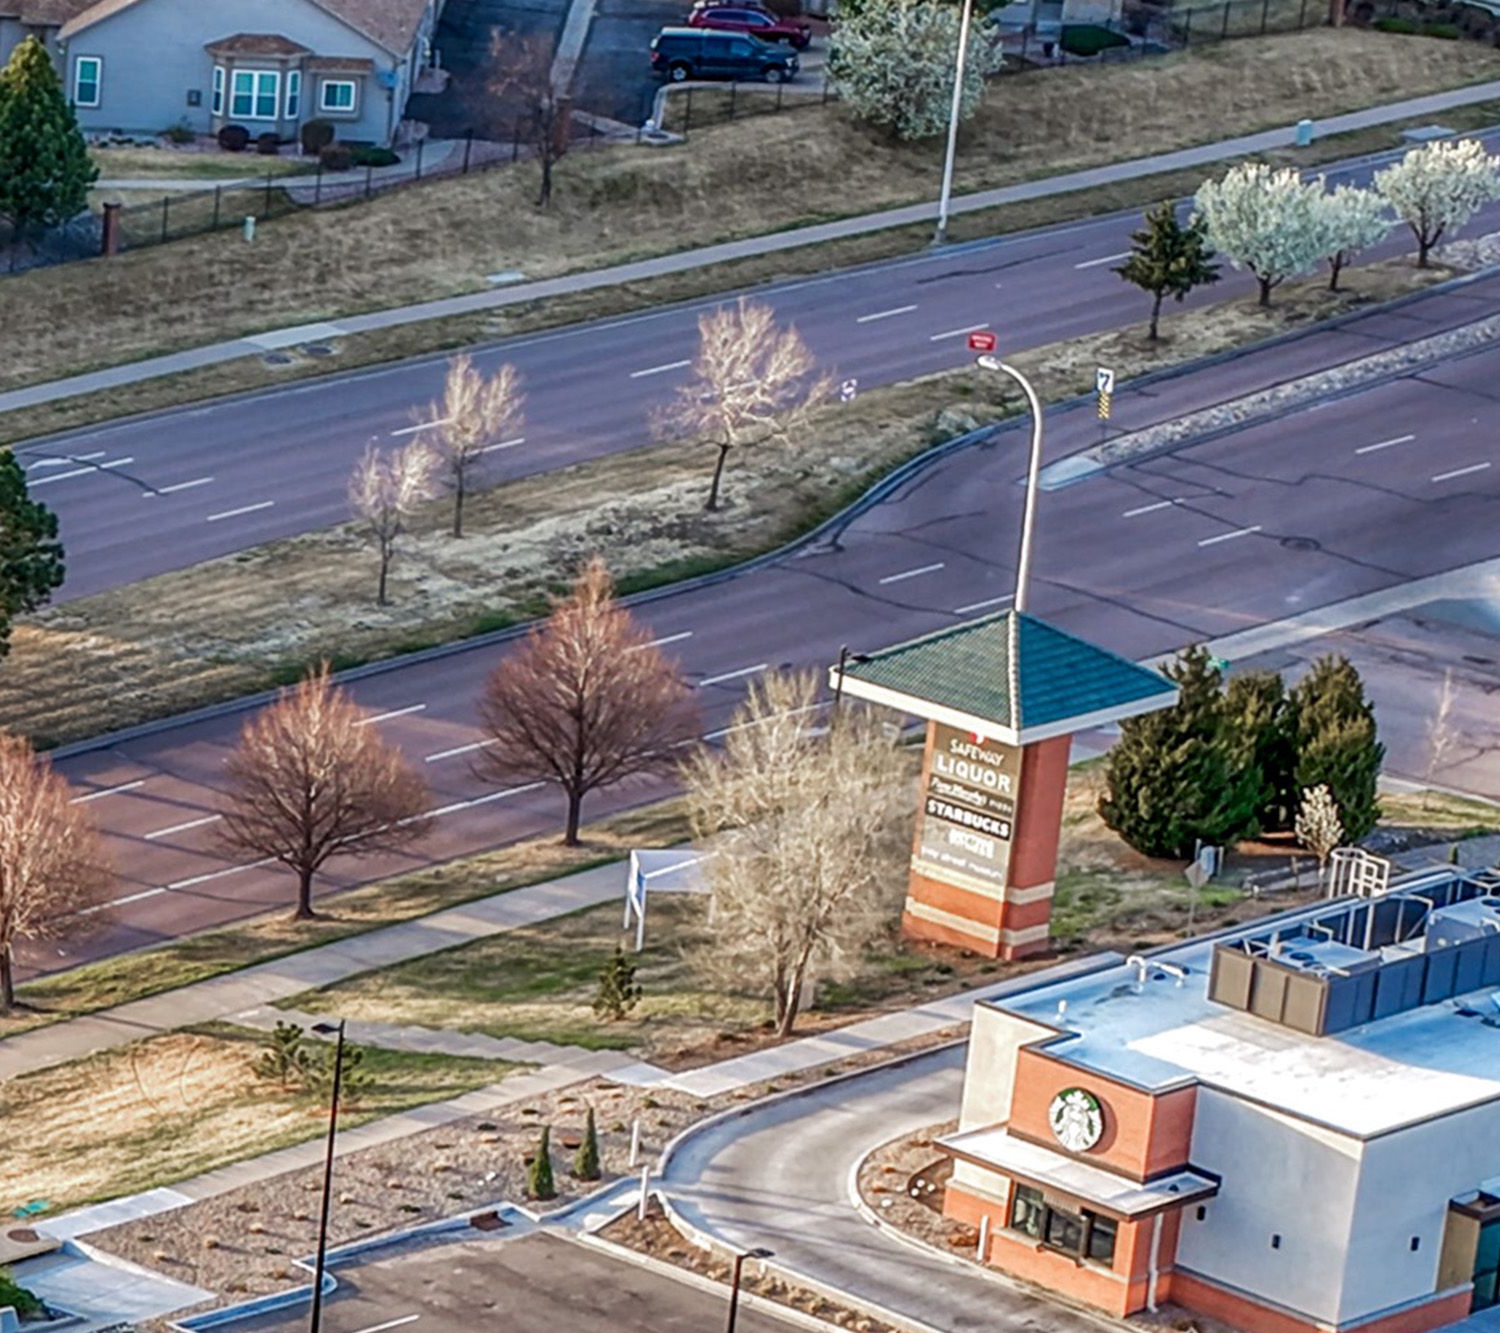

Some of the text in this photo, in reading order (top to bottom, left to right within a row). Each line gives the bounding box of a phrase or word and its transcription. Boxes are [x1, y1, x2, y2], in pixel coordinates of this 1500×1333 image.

[950, 738, 1004, 766] SAFEWAY
[937, 754, 1011, 793] LIQUOR
[927, 799, 1010, 838] STARBUCKS
